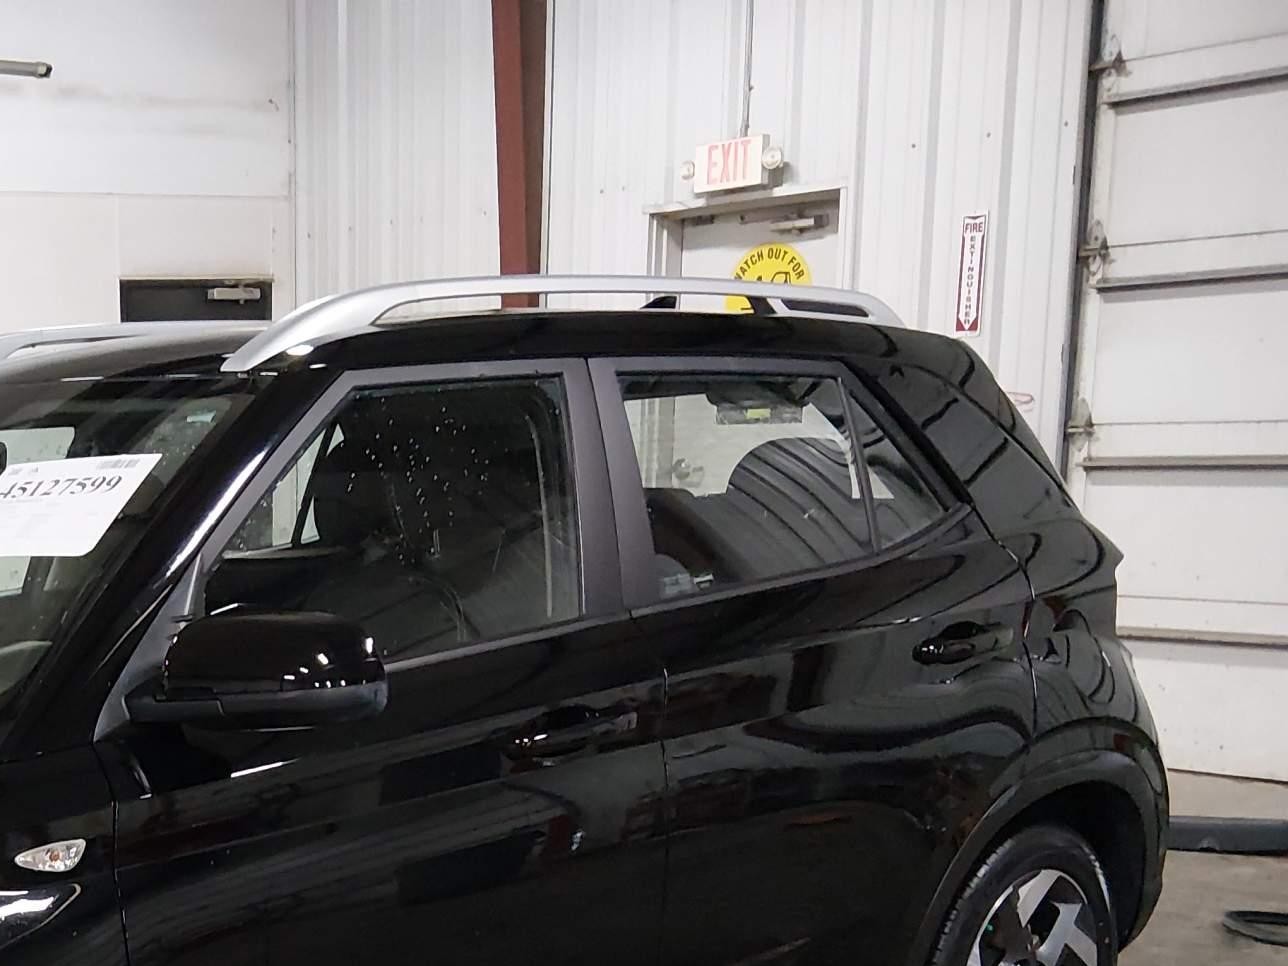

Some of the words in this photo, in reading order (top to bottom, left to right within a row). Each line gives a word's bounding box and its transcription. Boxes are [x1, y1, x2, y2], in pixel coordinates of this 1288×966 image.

[707, 139, 752, 185] EXIT
[964, 222, 983, 233] FIRE
[767, 247, 788, 262] OUT
[789, 255, 805, 280] FOR
[0, 475, 122, 499] 45127599
